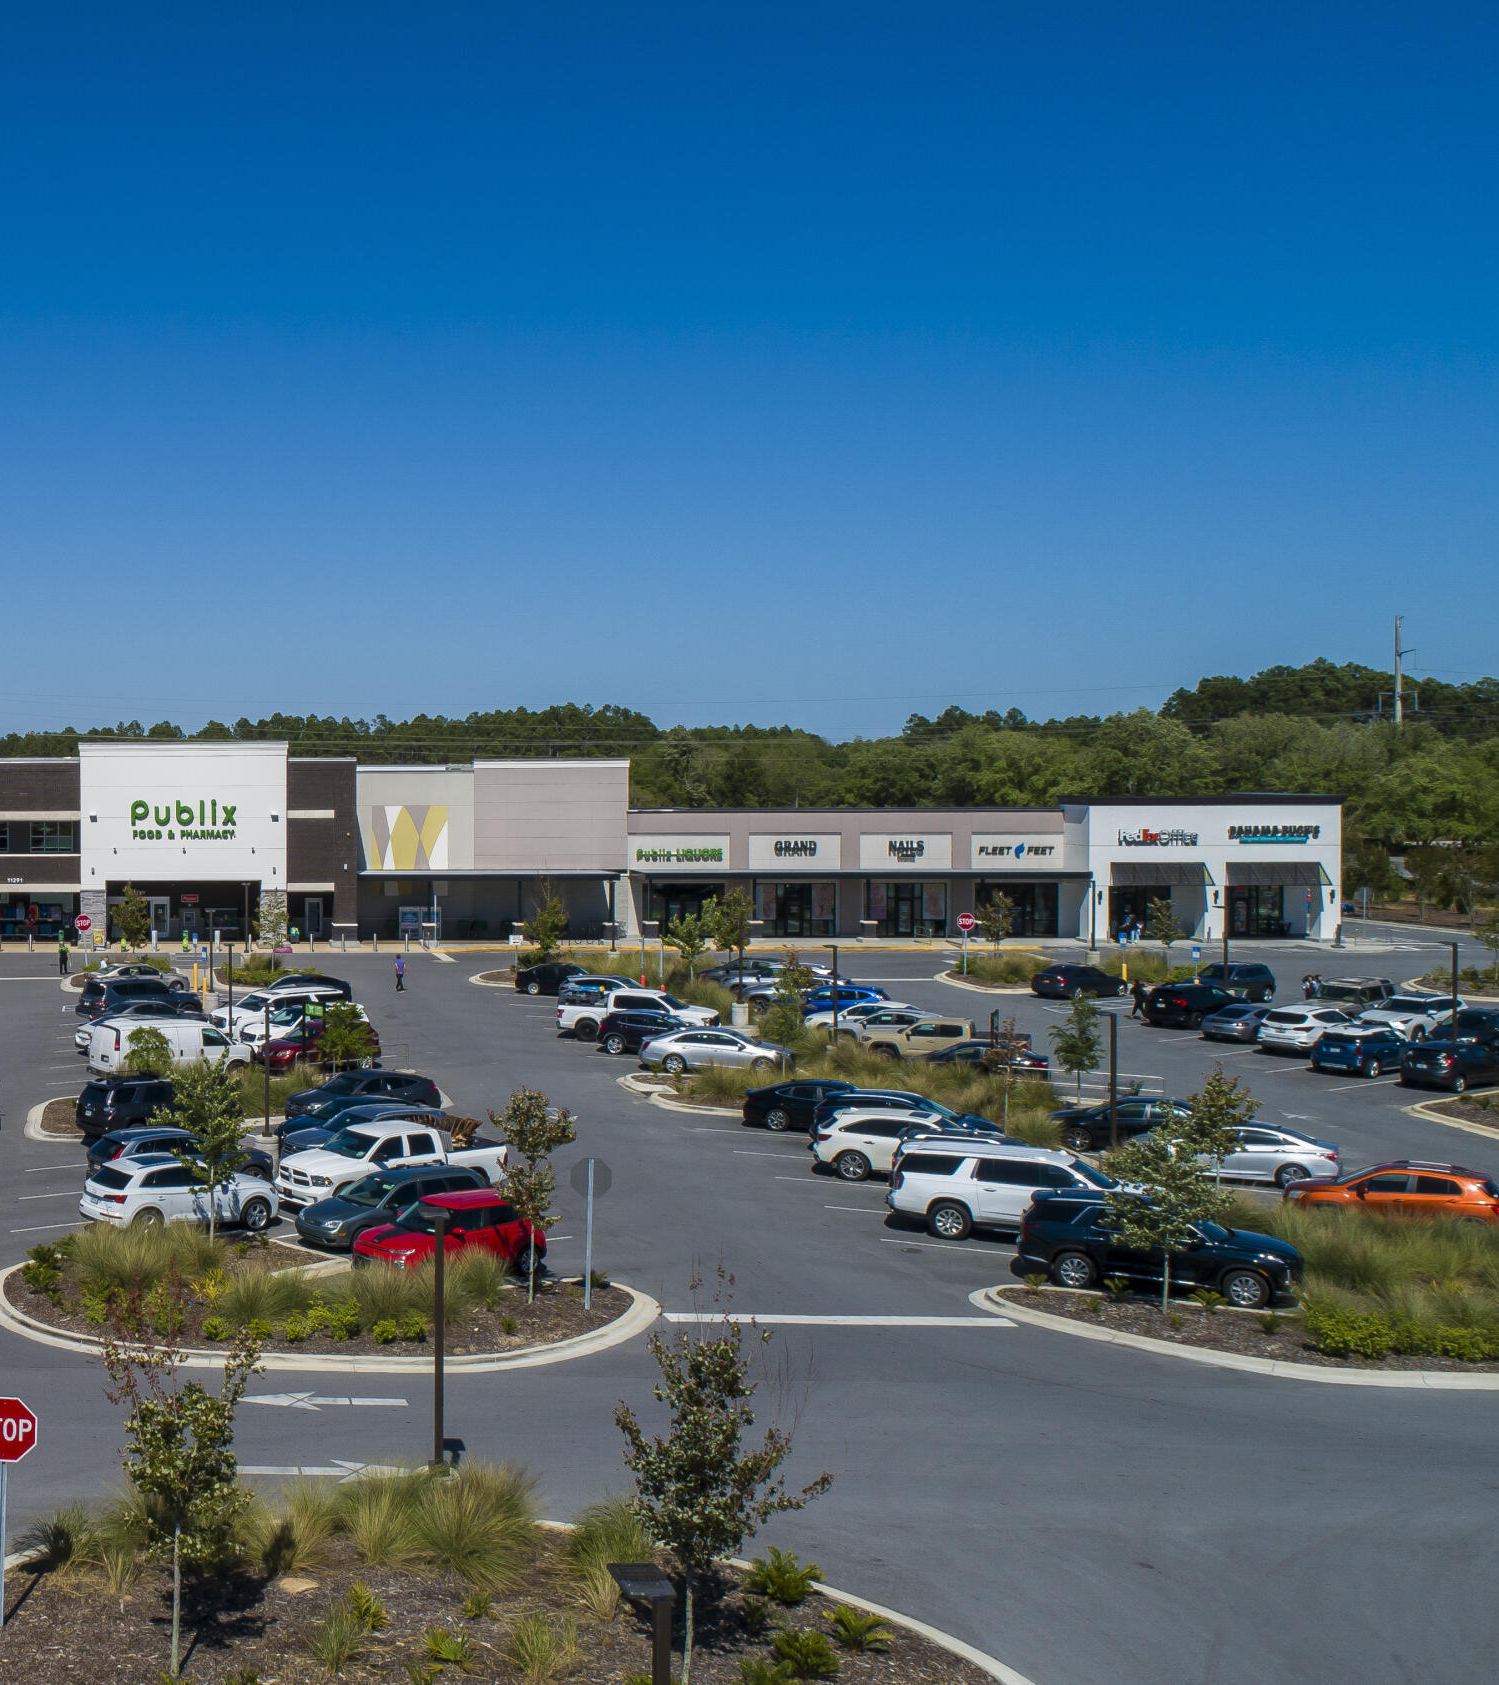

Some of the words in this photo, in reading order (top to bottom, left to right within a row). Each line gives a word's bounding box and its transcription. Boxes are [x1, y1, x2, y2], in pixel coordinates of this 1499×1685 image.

[131, 799, 237, 826] Publix
[132, 829, 163, 840] FOOD
[167, 829, 175, 840] &
[180, 829, 235, 840] PHARMACY
[774, 840, 817, 853] GRAND
[888, 840, 924, 853] NAILS
[978, 846, 1012, 856] FLEET
[1026, 846, 1055, 856] FEET
[676, 848, 723, 860] LIQUORS
[76, 919, 90, 927] STOP
